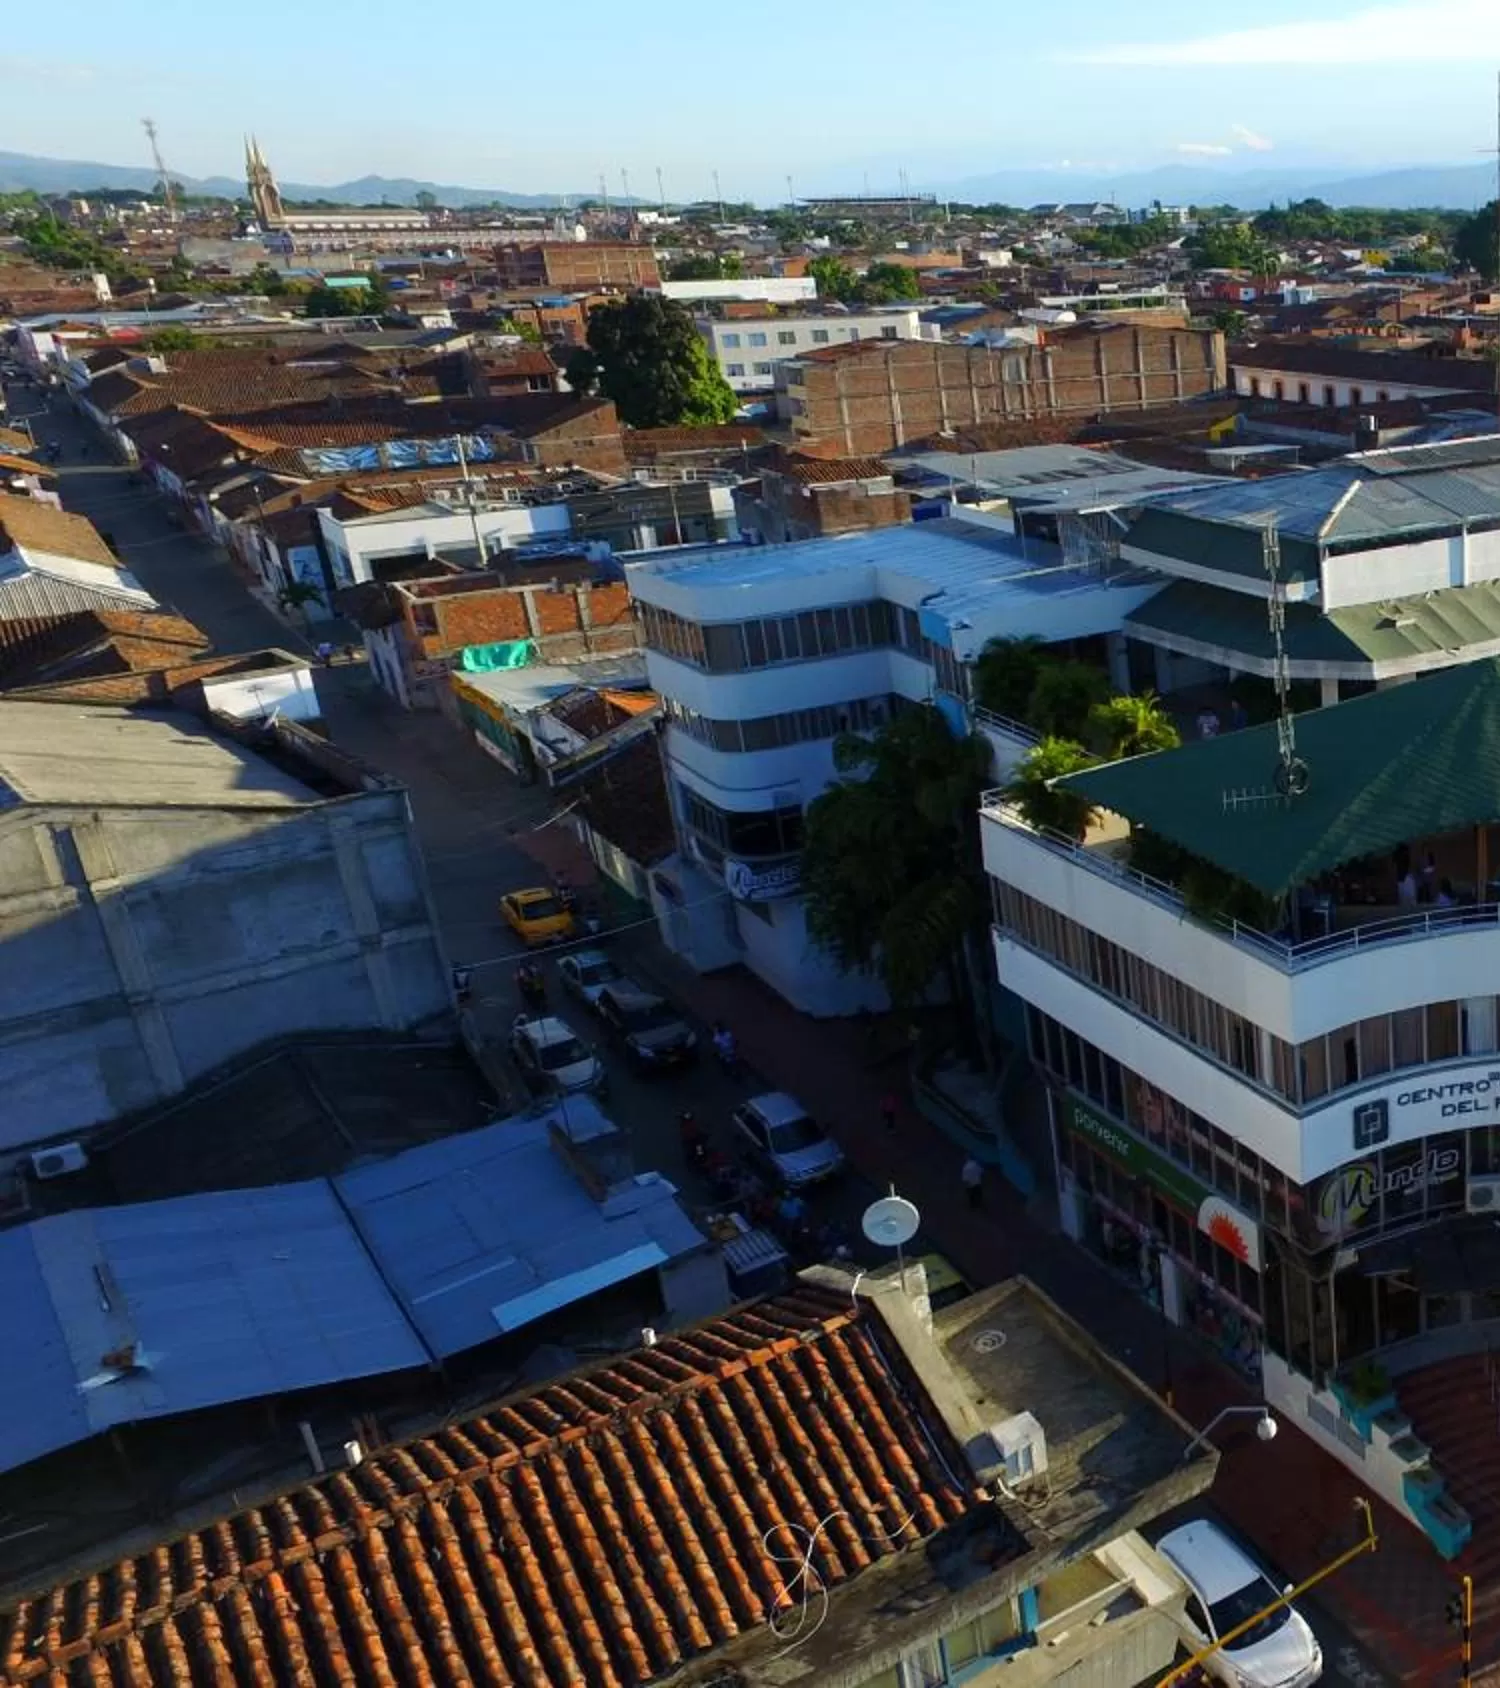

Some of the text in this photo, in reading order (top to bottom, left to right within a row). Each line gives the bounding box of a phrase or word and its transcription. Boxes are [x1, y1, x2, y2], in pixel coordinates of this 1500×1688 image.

[1396, 1079, 1490, 1107] CENTRO
[1441, 1100, 1489, 1118] DEL
[1321, 1149, 1460, 1216] Mundo
